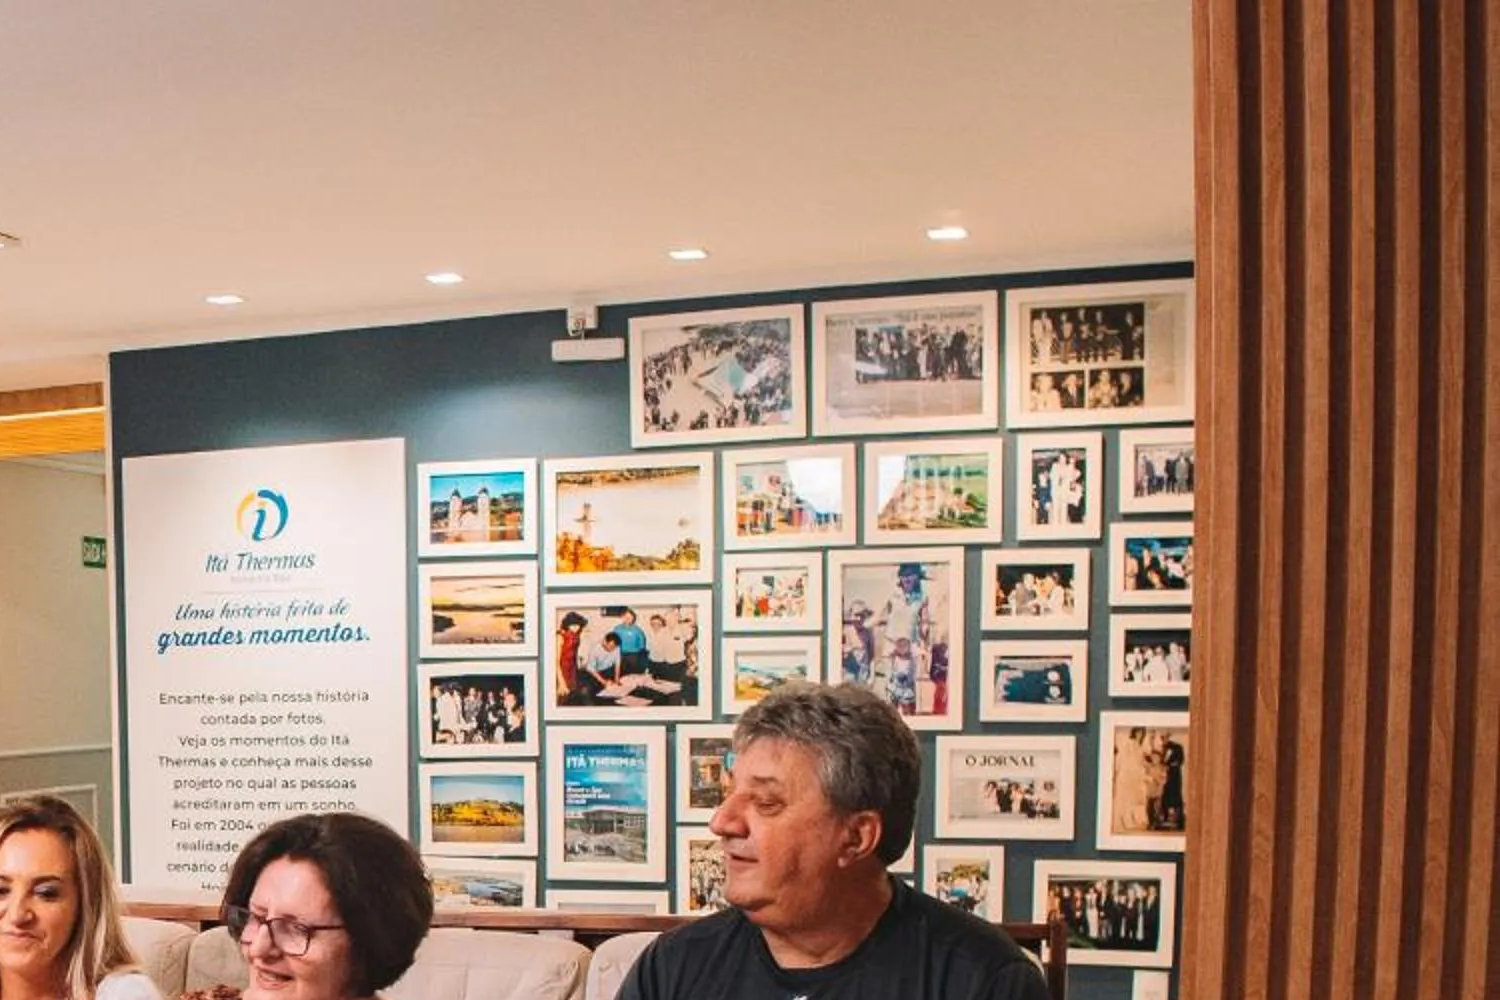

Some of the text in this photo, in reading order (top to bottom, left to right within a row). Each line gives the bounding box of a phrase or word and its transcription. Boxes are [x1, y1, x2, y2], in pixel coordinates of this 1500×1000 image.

[205, 552, 316, 573] Itá Thermas
[175, 597, 350, 621] Uma história feita de
[157, 622, 370, 655] grandes momentos.
[159, 689, 370, 706] Encante-se pela nossa história
[200, 712, 257, 726] contada
[260, 714, 284, 727] por
[179, 735, 207, 749] Veja
[211, 736, 226, 747] os
[229, 735, 306, 747] momentos
[309, 733, 327, 747] do
[158, 755, 373, 771] Thermas e conheça mais desse
[565, 753, 587, 769] ITÁ
[964, 754, 977, 768] O
[173, 777, 357, 793] projeto no qual as pessoas
[173, 799, 255, 811] acreditaram
[258, 800, 281, 811] em
[285, 800, 307, 811] um
[171, 819, 191, 831] Foi
[194, 821, 217, 831] em
[220, 819, 254, 831] 2004
[176, 840, 240, 852] realidade
